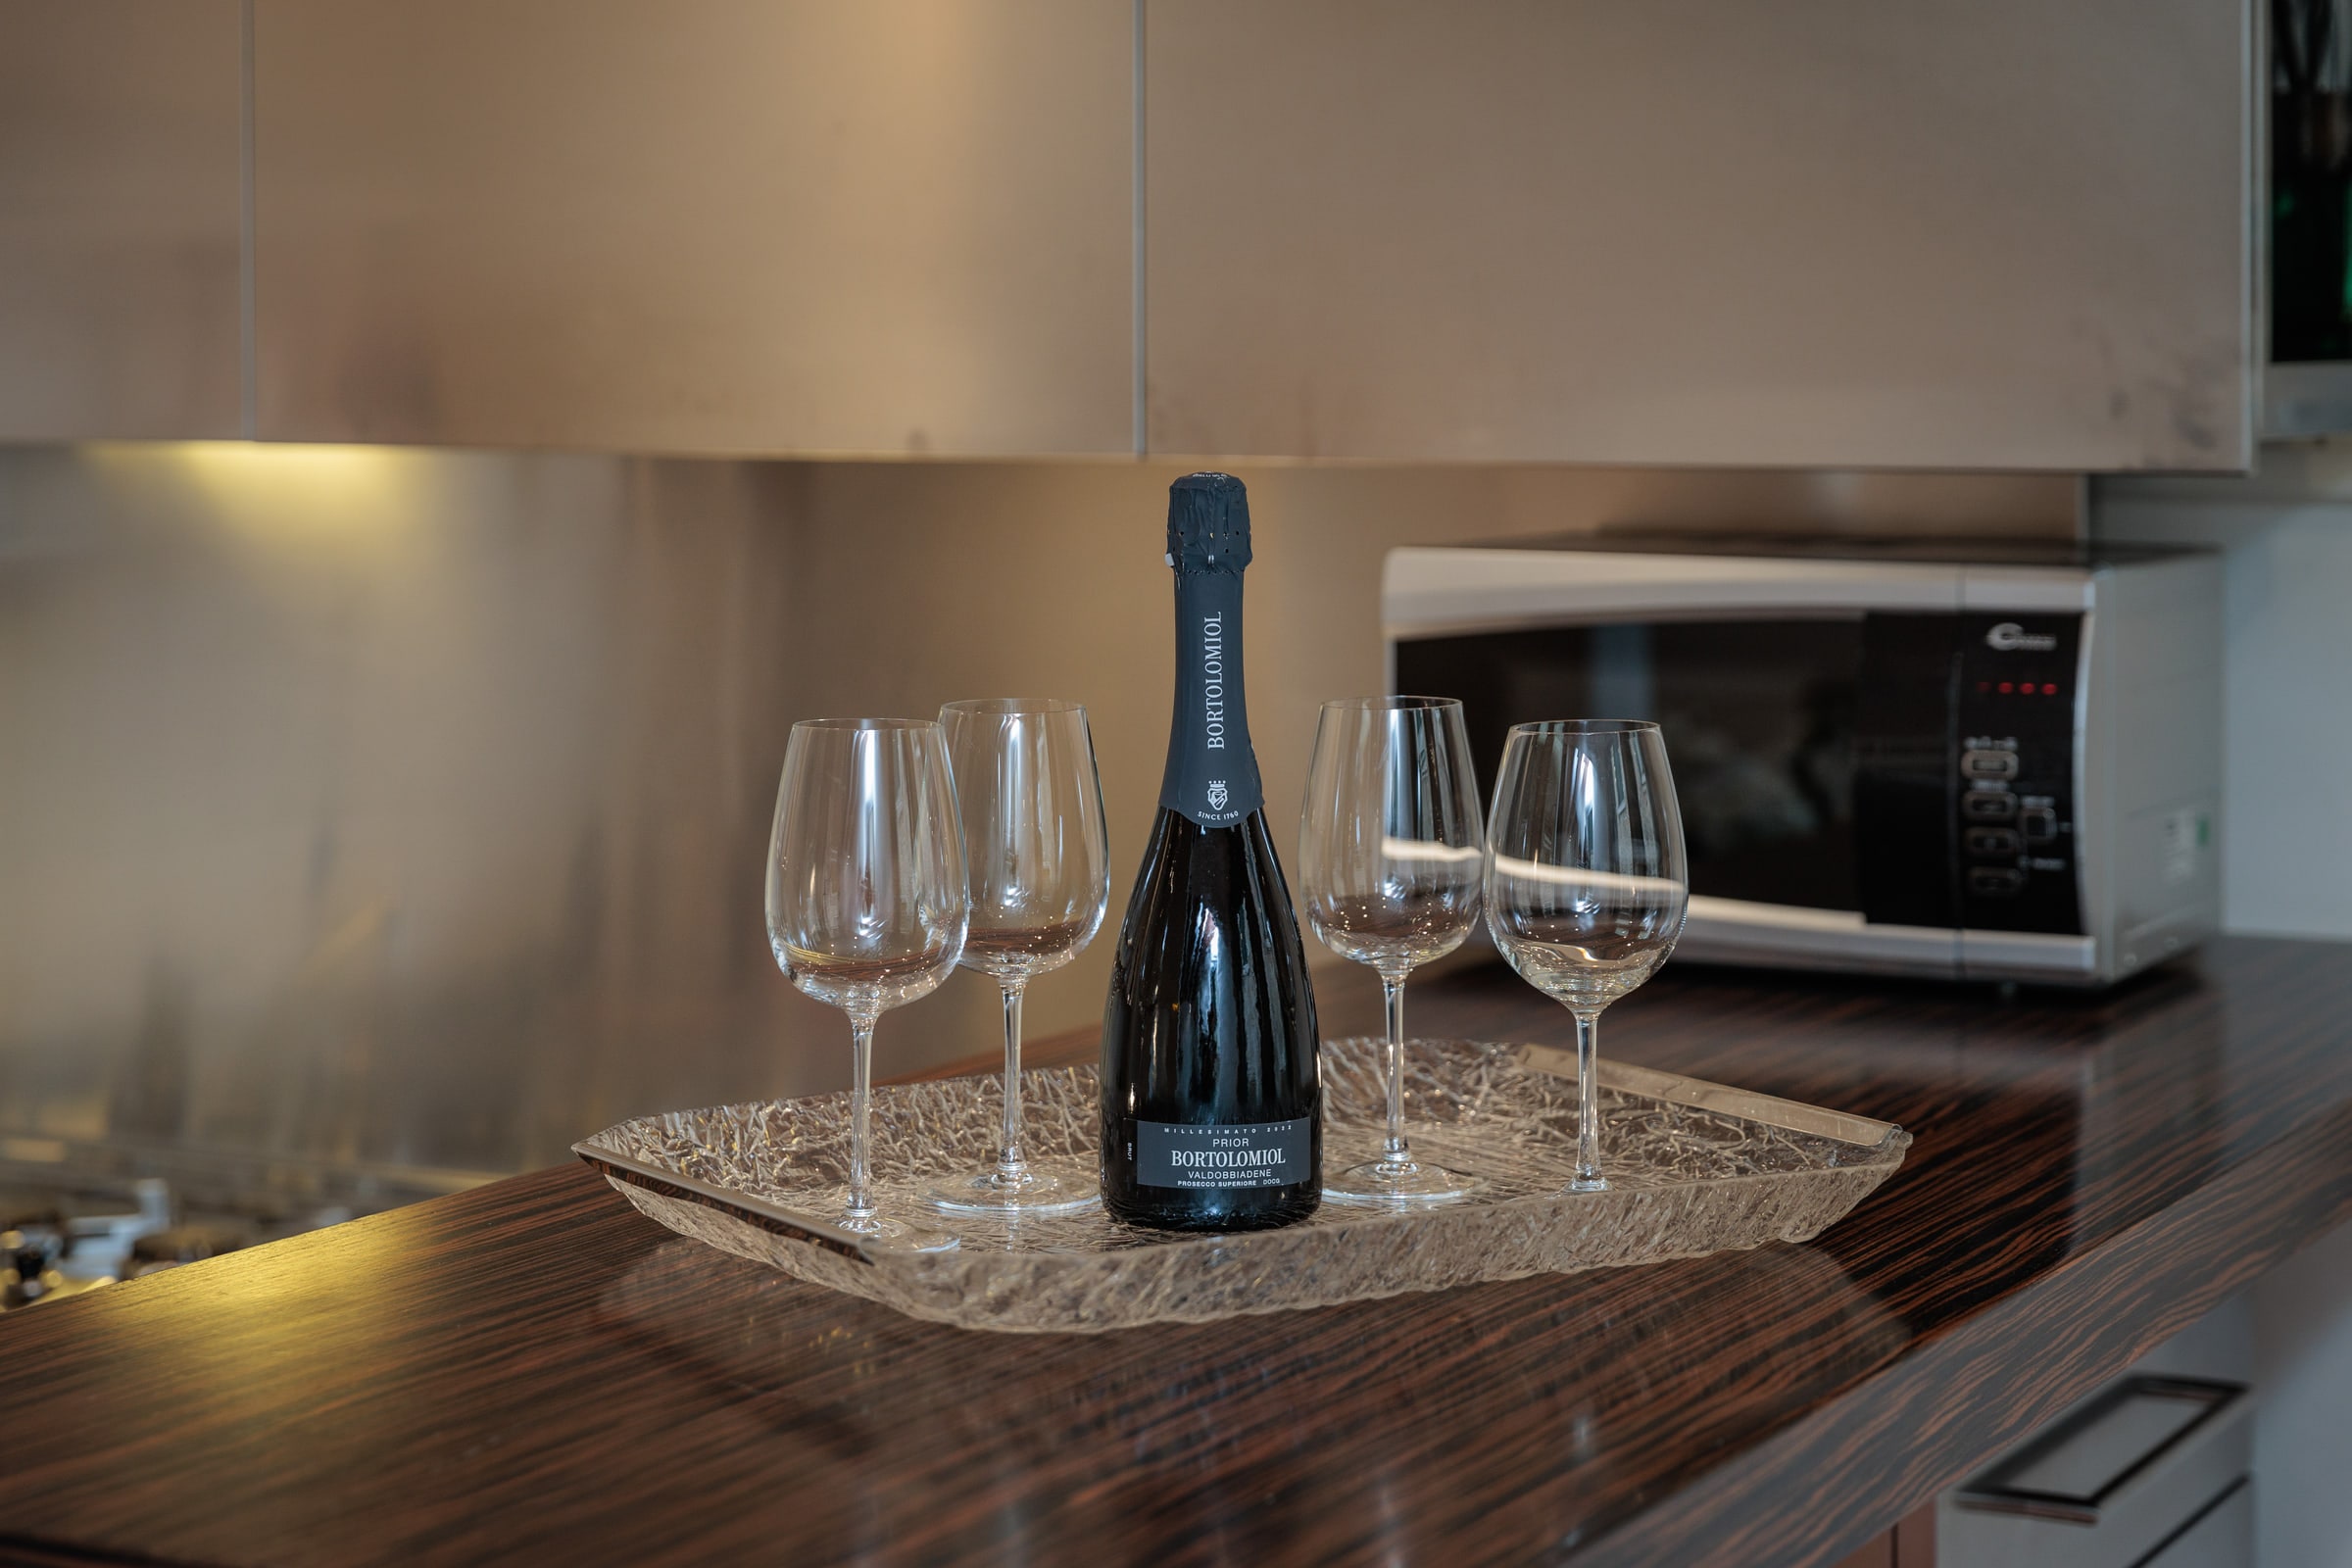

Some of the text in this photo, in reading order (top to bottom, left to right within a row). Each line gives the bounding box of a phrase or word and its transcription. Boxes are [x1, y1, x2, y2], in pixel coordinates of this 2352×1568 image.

[1203, 611, 1225, 750] BORTOLOMIOL
[1197, 809, 1239, 821] SINCE 1760
[1212, 1138, 1250, 1148] PRIOR
[1171, 1148, 1286, 1167] BORTOLOMIOL
[1188, 1168, 1272, 1180] VALDOBBIADENE
